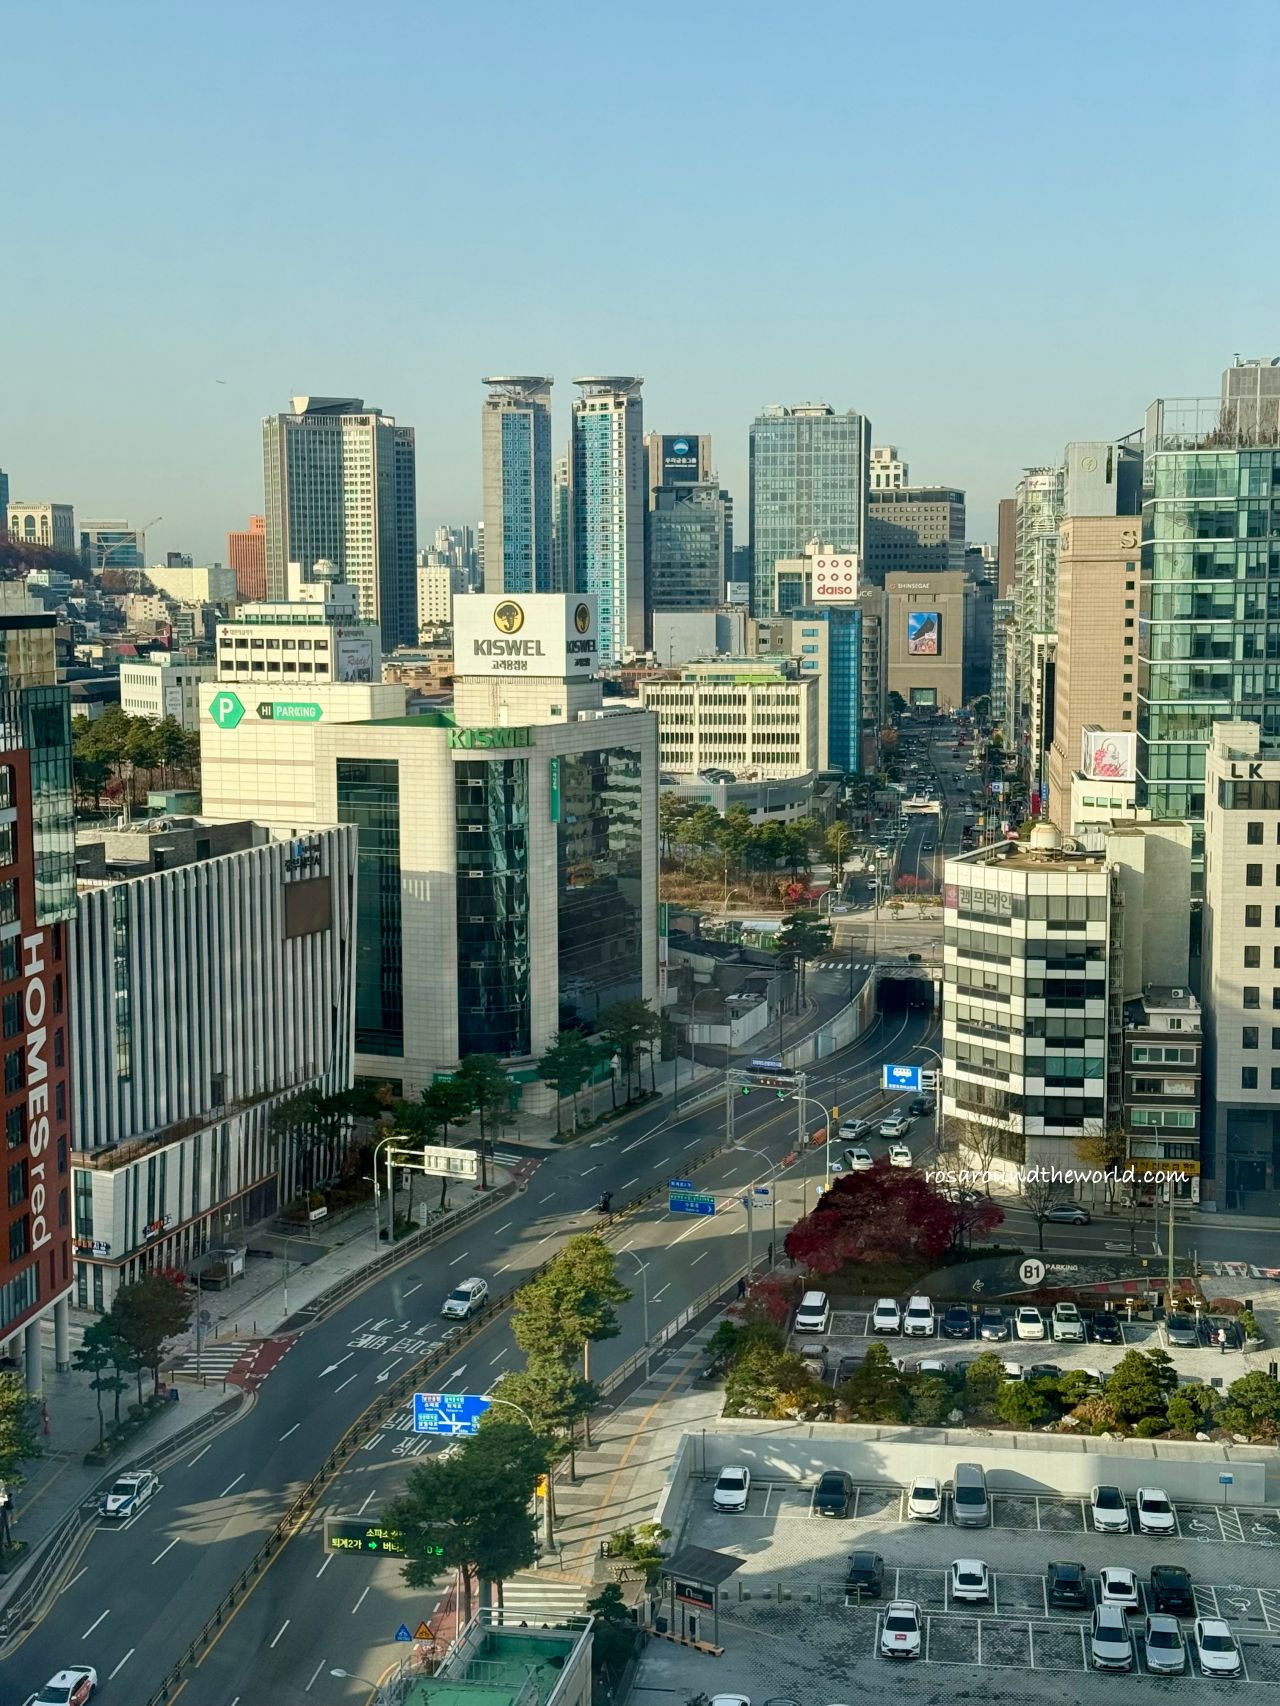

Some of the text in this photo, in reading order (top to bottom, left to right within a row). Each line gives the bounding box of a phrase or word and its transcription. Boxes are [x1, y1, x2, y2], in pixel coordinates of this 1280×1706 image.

[817, 583, 853, 596] daiso
[473, 639, 546, 656] KISWEL
[566, 639, 598, 654] KISWEL
[491, 660, 528, 671] 고려용접봉
[219, 698, 234, 723] P
[261, 705, 316, 718] HI PARKING
[447, 727, 536, 749] KISWEL
[959, 888, 1012, 911] 캠프라인
[23, 931, 52, 1251] HOMES red
[1024, 1264, 1040, 1279] B1
[1045, 1263, 1079, 1272] PARKING
[331, 1537, 362, 1550] 퇴계2가
